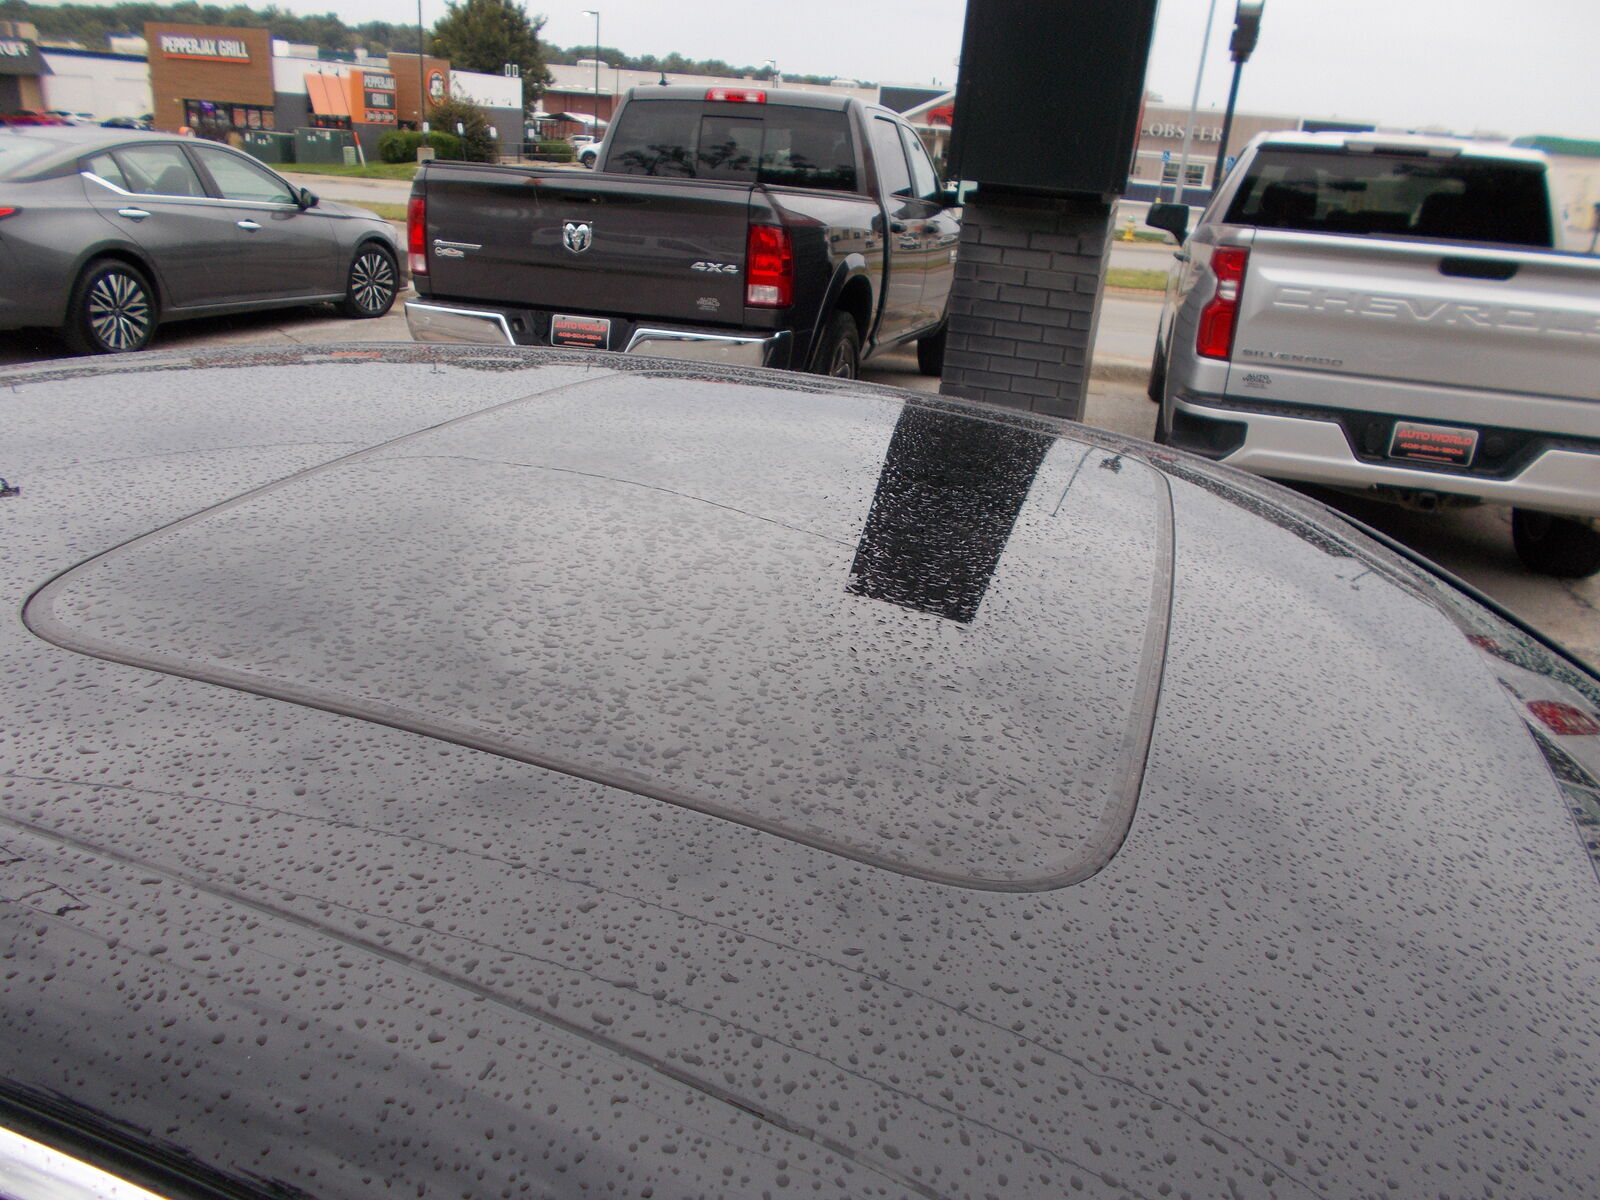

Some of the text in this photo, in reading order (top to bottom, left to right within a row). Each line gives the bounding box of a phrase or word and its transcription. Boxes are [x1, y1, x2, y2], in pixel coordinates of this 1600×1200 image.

[161, 36, 248, 57] PEPPERJAX GRILL
[555, 321, 607, 332] AUTO WORLD
[1242, 348, 1343, 365] SILVERADO
[1398, 429, 1472, 446] AUTO WORLD
